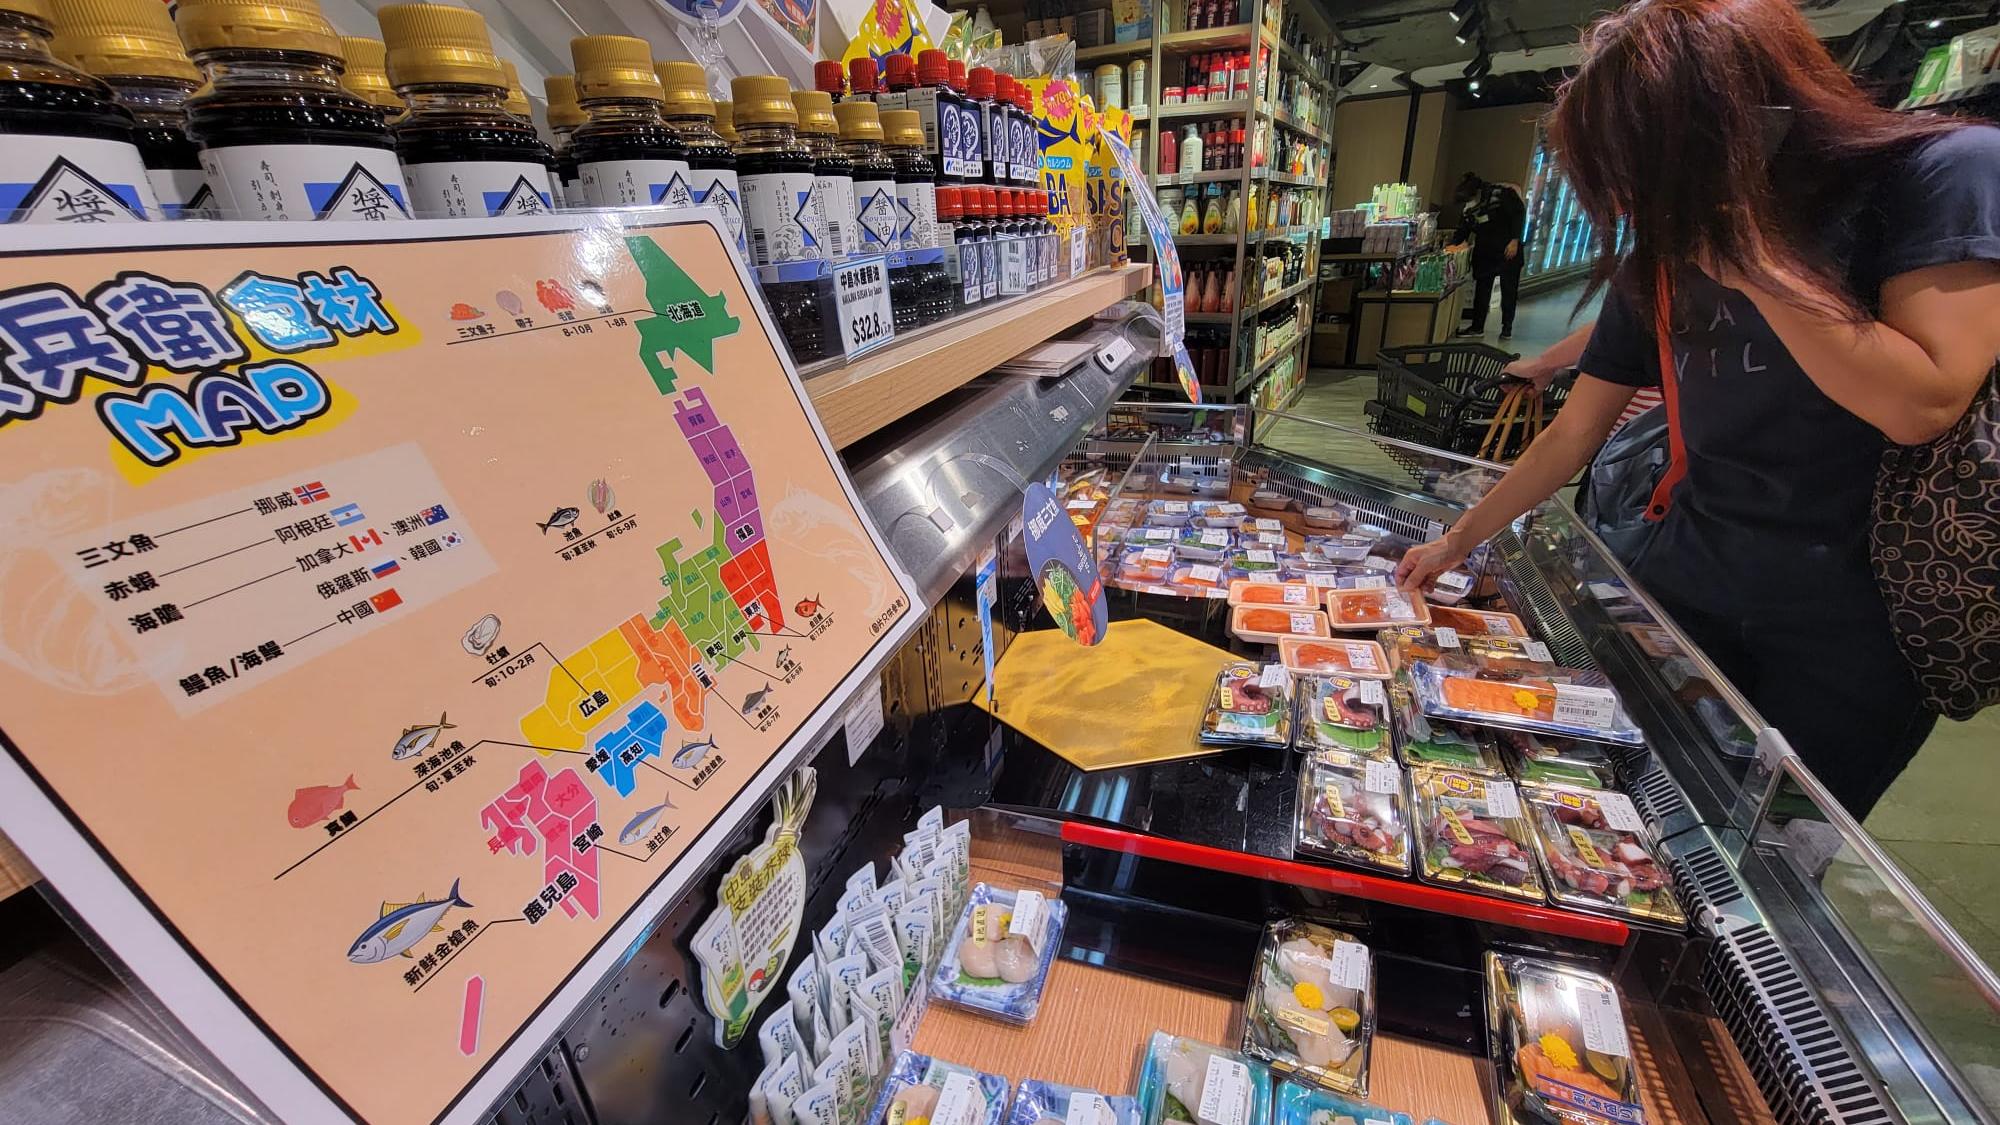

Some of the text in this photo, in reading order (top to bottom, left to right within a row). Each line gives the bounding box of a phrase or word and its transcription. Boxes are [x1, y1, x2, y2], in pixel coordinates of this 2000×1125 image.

[604, 317, 628, 329] 1-8月
[668, 302, 706, 322] 北海道
[456, 323, 496, 339] 三文魚子
[562, 323, 593, 338] 8-10月
[852, 311, 881, 347] $32.8
[253, 491, 298, 516] 挪威
[274, 513, 336, 544] 阿根廷
[562, 526, 584, 542] 池魚
[735, 524, 755, 541] 福島
[76, 533, 159, 569] 三文魚
[296, 542, 354, 573] 加拿大
[103, 570, 160, 602] 赤蝦
[316, 566, 373, 600] 俄羅斯
[660, 570, 679, 587] 石川
[128, 603, 185, 635] 海膽
[336, 600, 375, 624] 中國
[706, 641, 724, 658] 愛知
[178, 639, 286, 697] 鰻魚/海鰻
[692, 664, 713, 689] 三重
[578, 690, 609, 717] 広島
[412, 739, 466, 779] 深海池魚
[585, 749, 610, 773] 愛媛
[620, 742, 643, 765] 高知
[554, 782, 581, 808] 大分
[572, 823, 604, 854] 宮崎
[645, 825, 673, 853] 油甘魚
[725, 861, 754, 902] 中島
[522, 872, 578, 925] 鹿兒島
[403, 918, 480, 987] 新鮮金槍魚
